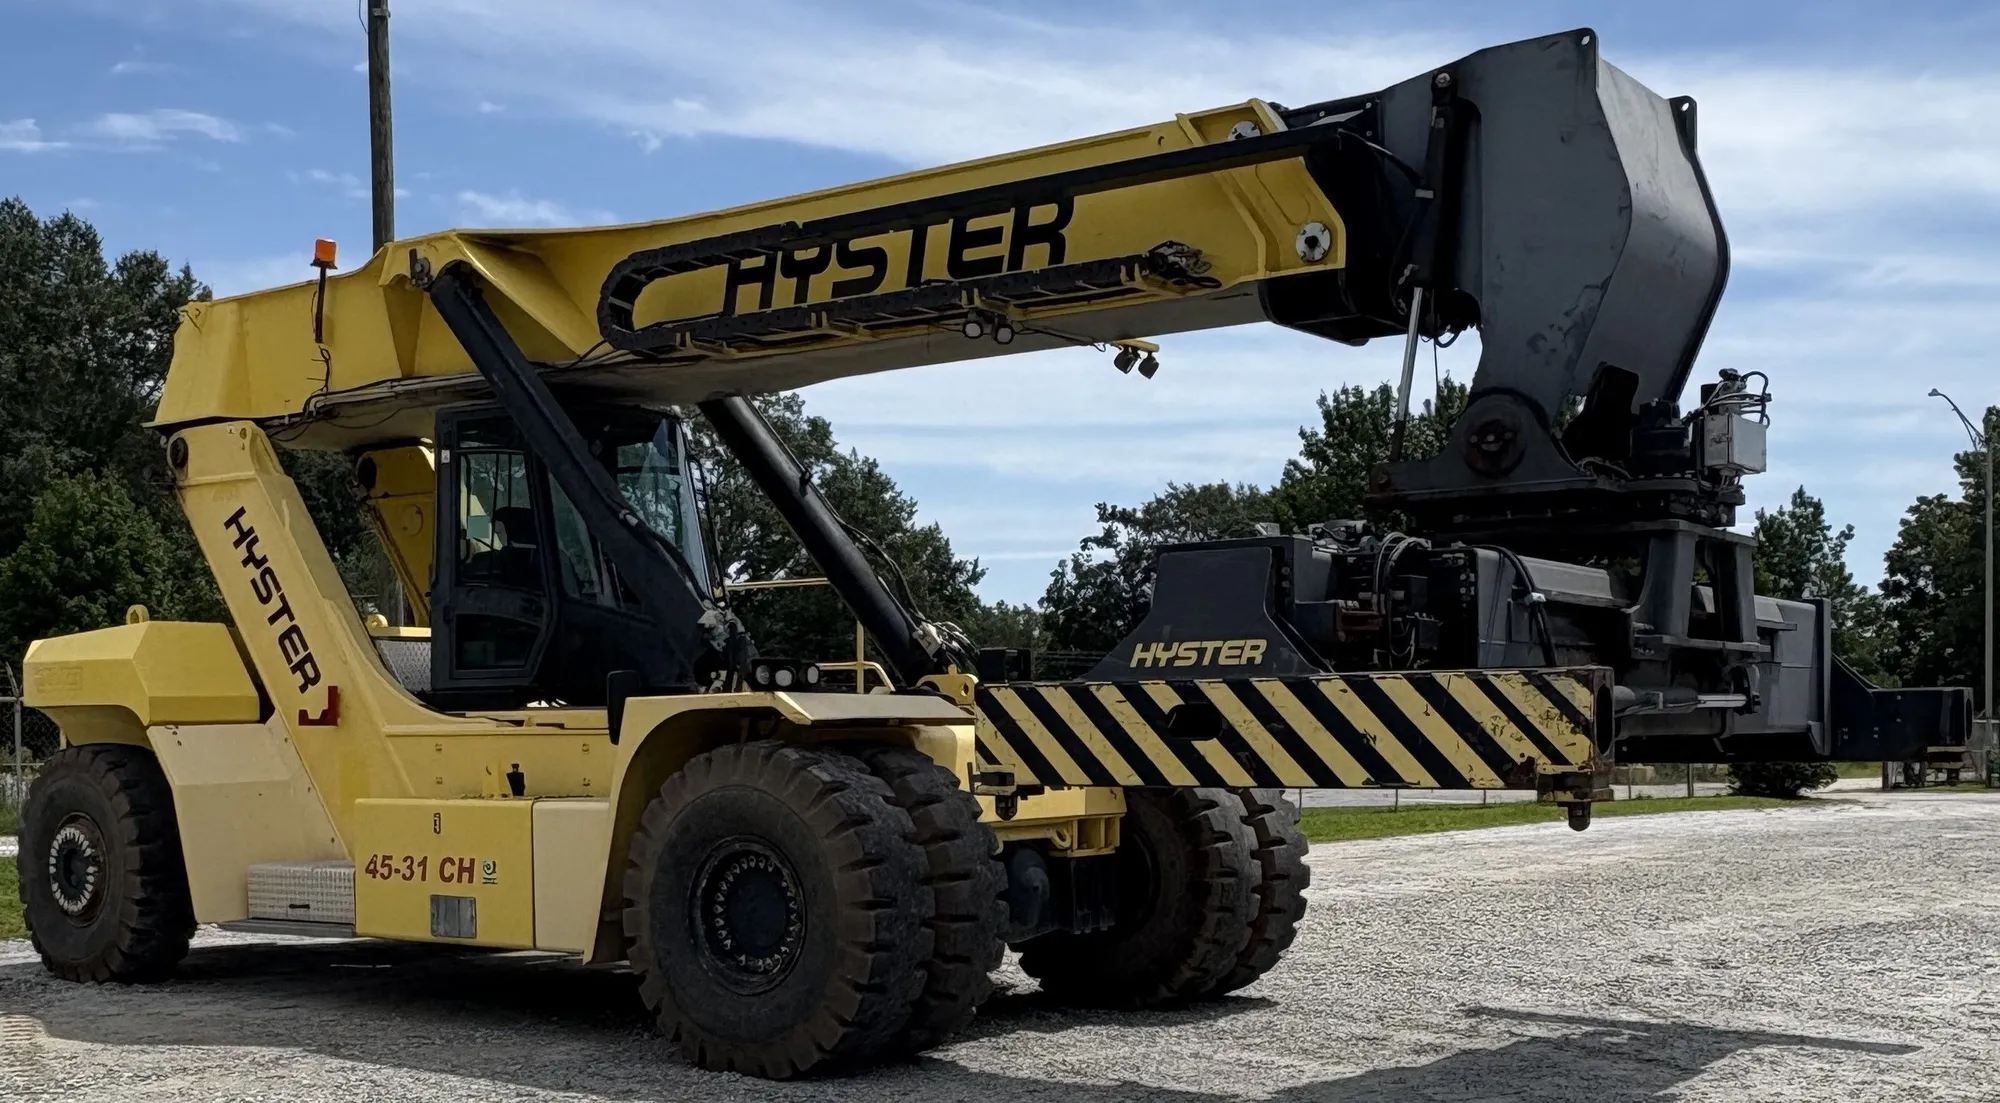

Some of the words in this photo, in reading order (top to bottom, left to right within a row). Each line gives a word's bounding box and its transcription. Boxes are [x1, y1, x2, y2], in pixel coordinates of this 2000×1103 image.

[722, 201, 1074, 317] HYSTER
[223, 505, 322, 694] HYSTER
[1129, 639, 1267, 668] HYSTER
[365, 853, 428, 882] 45-31
[438, 856, 476, 884] CH
